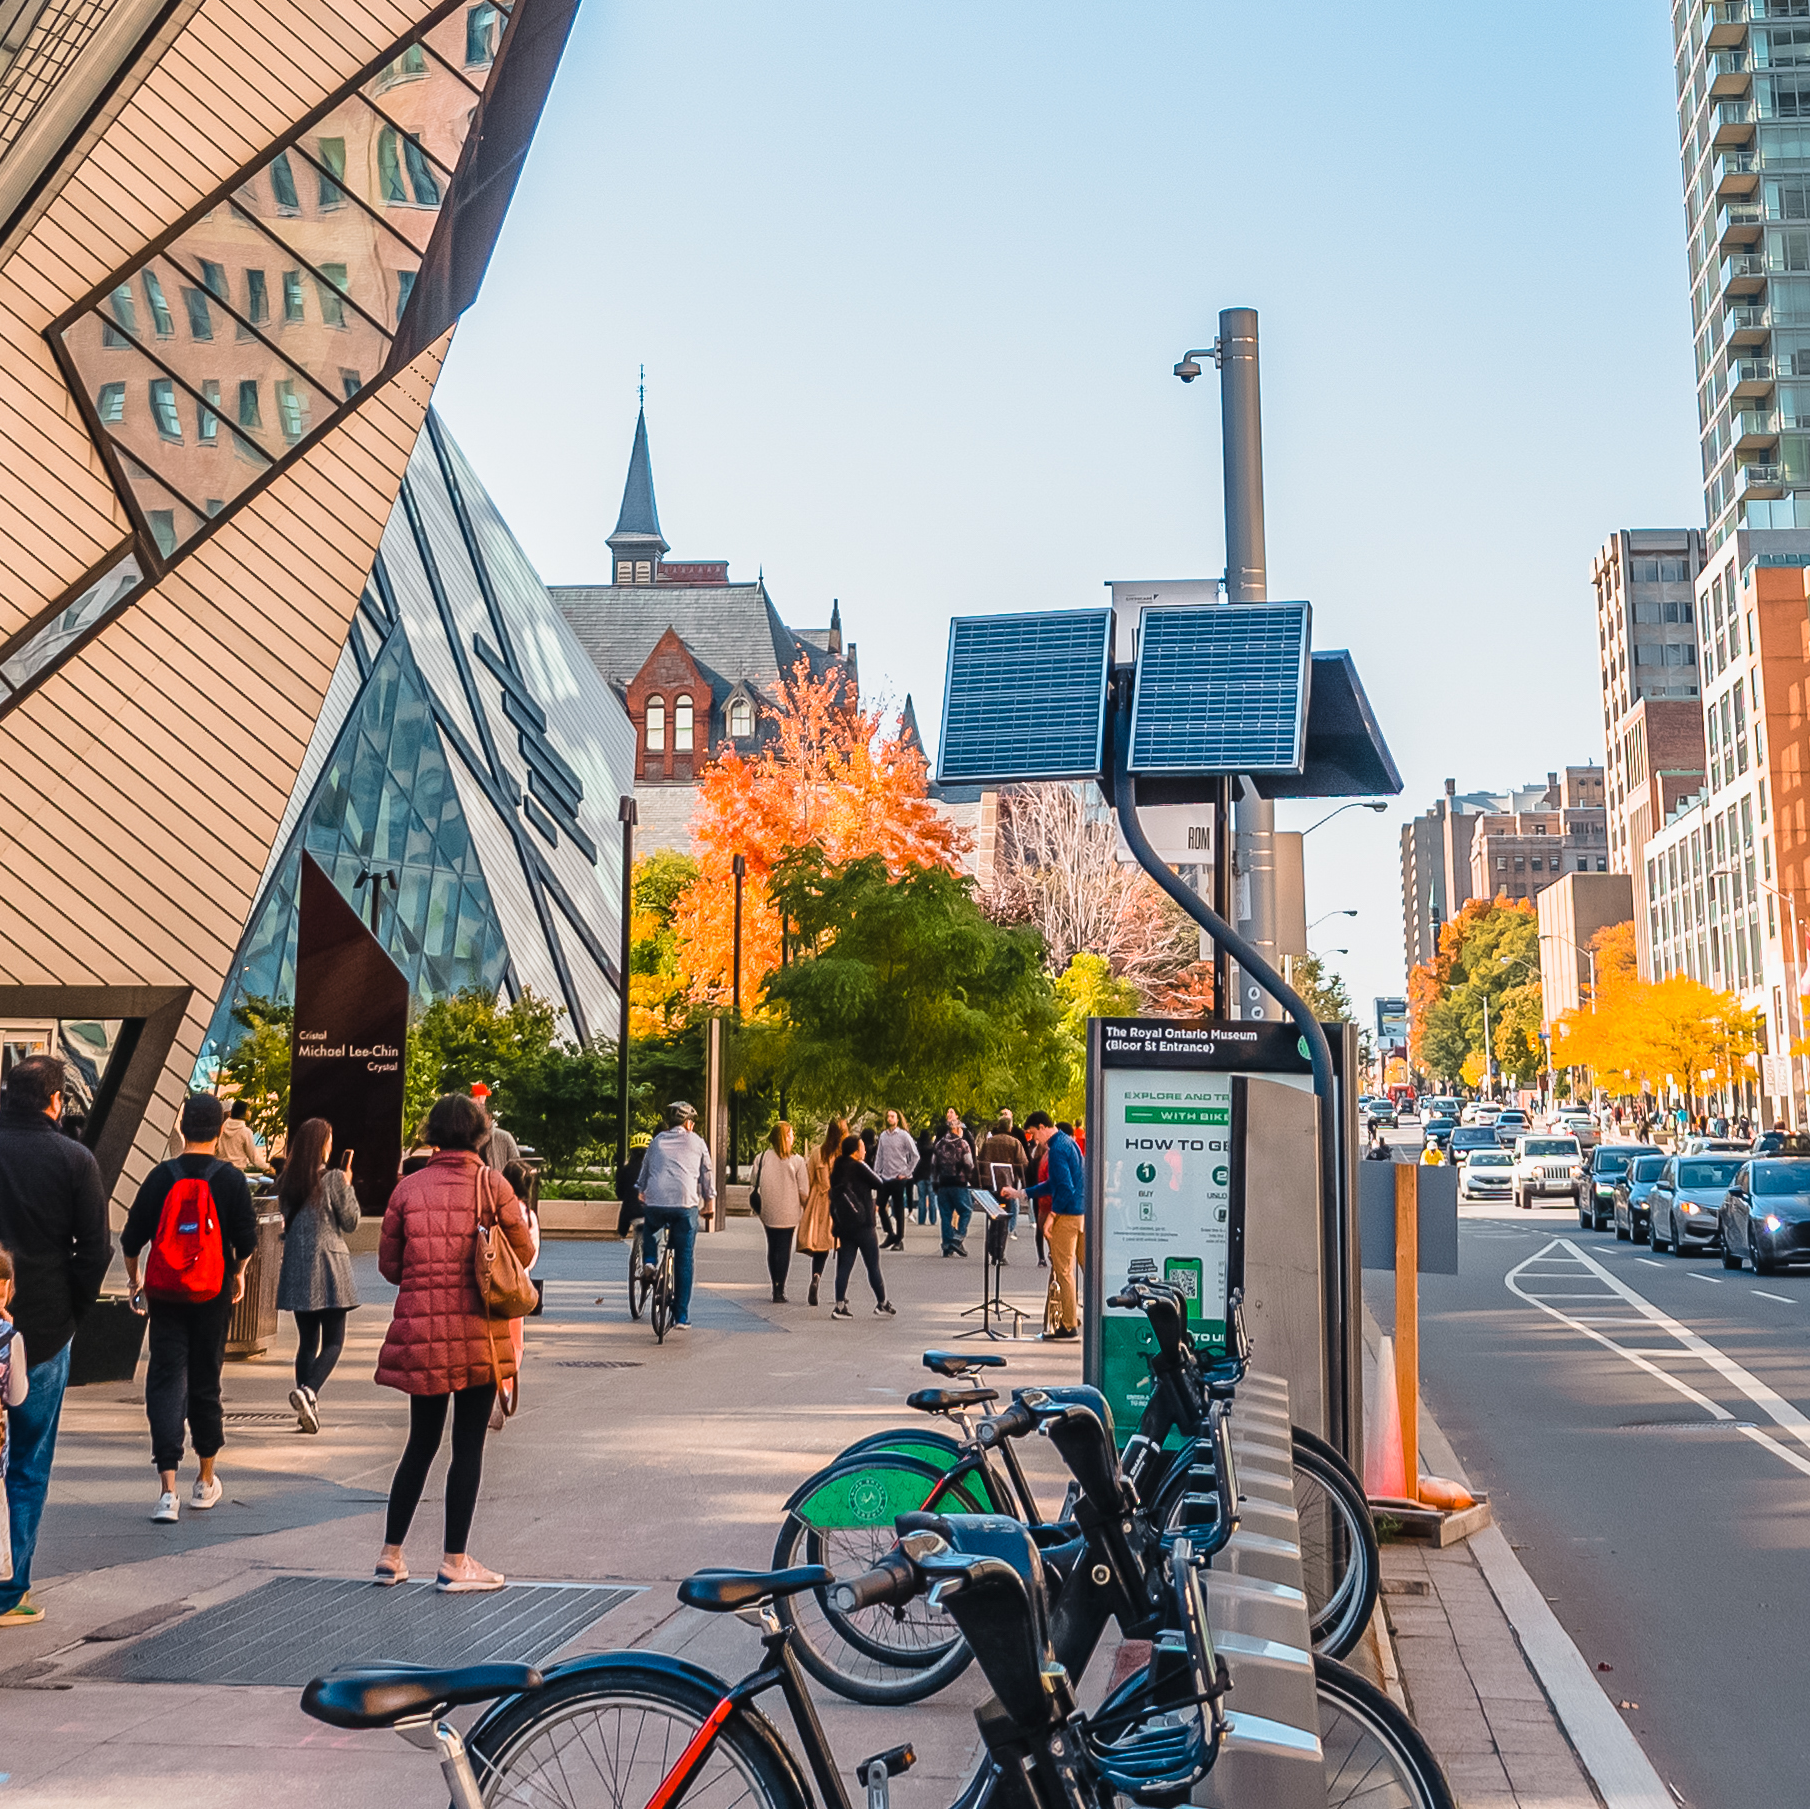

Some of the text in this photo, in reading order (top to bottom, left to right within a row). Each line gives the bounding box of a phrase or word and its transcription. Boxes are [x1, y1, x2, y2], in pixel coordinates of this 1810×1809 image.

[1188, 827, 1210, 850] ROM
[299, 1030, 327, 1040] Cristal
[1106, 1027, 1258, 1041] The Royal Ontario Museum
[299, 1044, 399, 1057] Michael Lee-Chin
[1105, 1041, 1215, 1054] (Bloor St Entrance)
[367, 1062, 398, 1073] Crystal
[1124, 1091, 1182, 1101] EXPLORE
[1184, 1092, 1212, 1101] AND
[1161, 1111, 1196, 1121] WITH
[1125, 1138, 1173, 1150] HOW
[1177, 1139, 1204, 1151] TO
